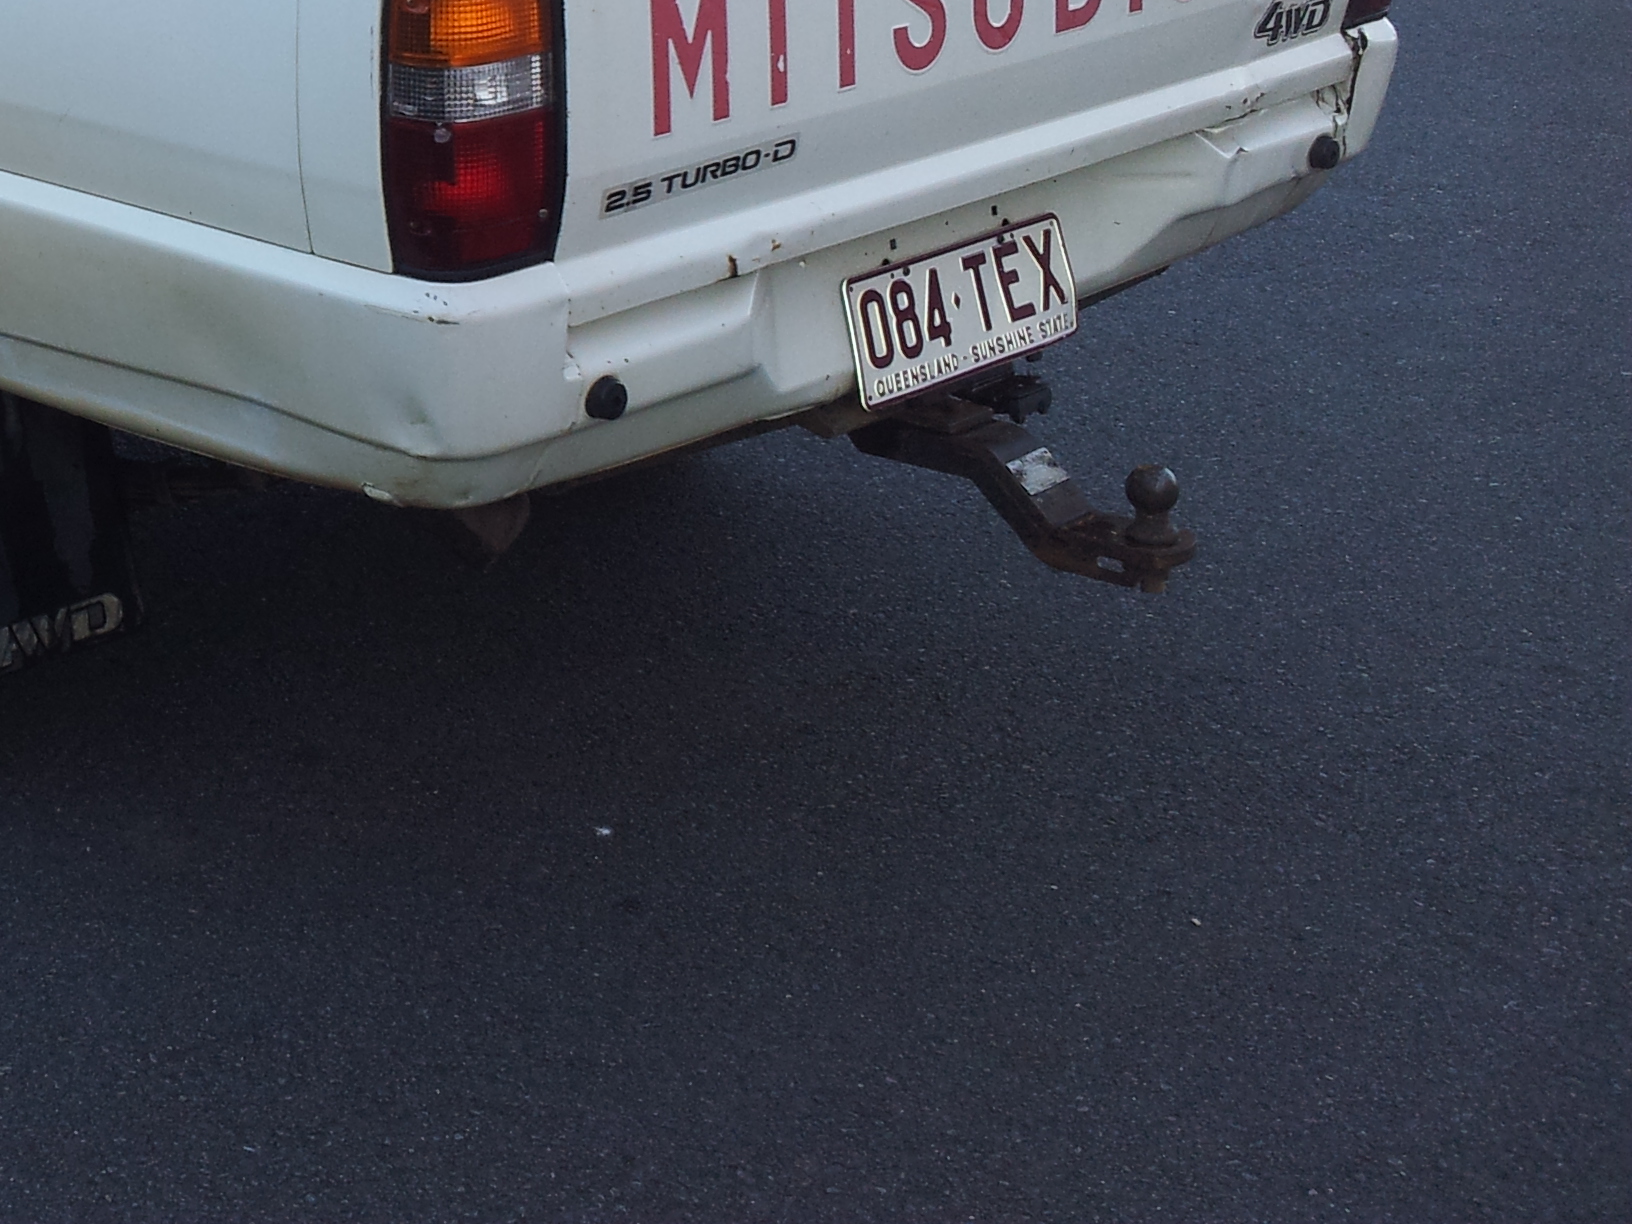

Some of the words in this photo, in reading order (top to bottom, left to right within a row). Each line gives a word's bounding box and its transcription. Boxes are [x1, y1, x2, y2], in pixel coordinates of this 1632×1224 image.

[604, 181, 653, 213] 2.5
[874, 354, 959, 397] QUEENSLAND
[971, 327, 1035, 364] SUNSHINE
